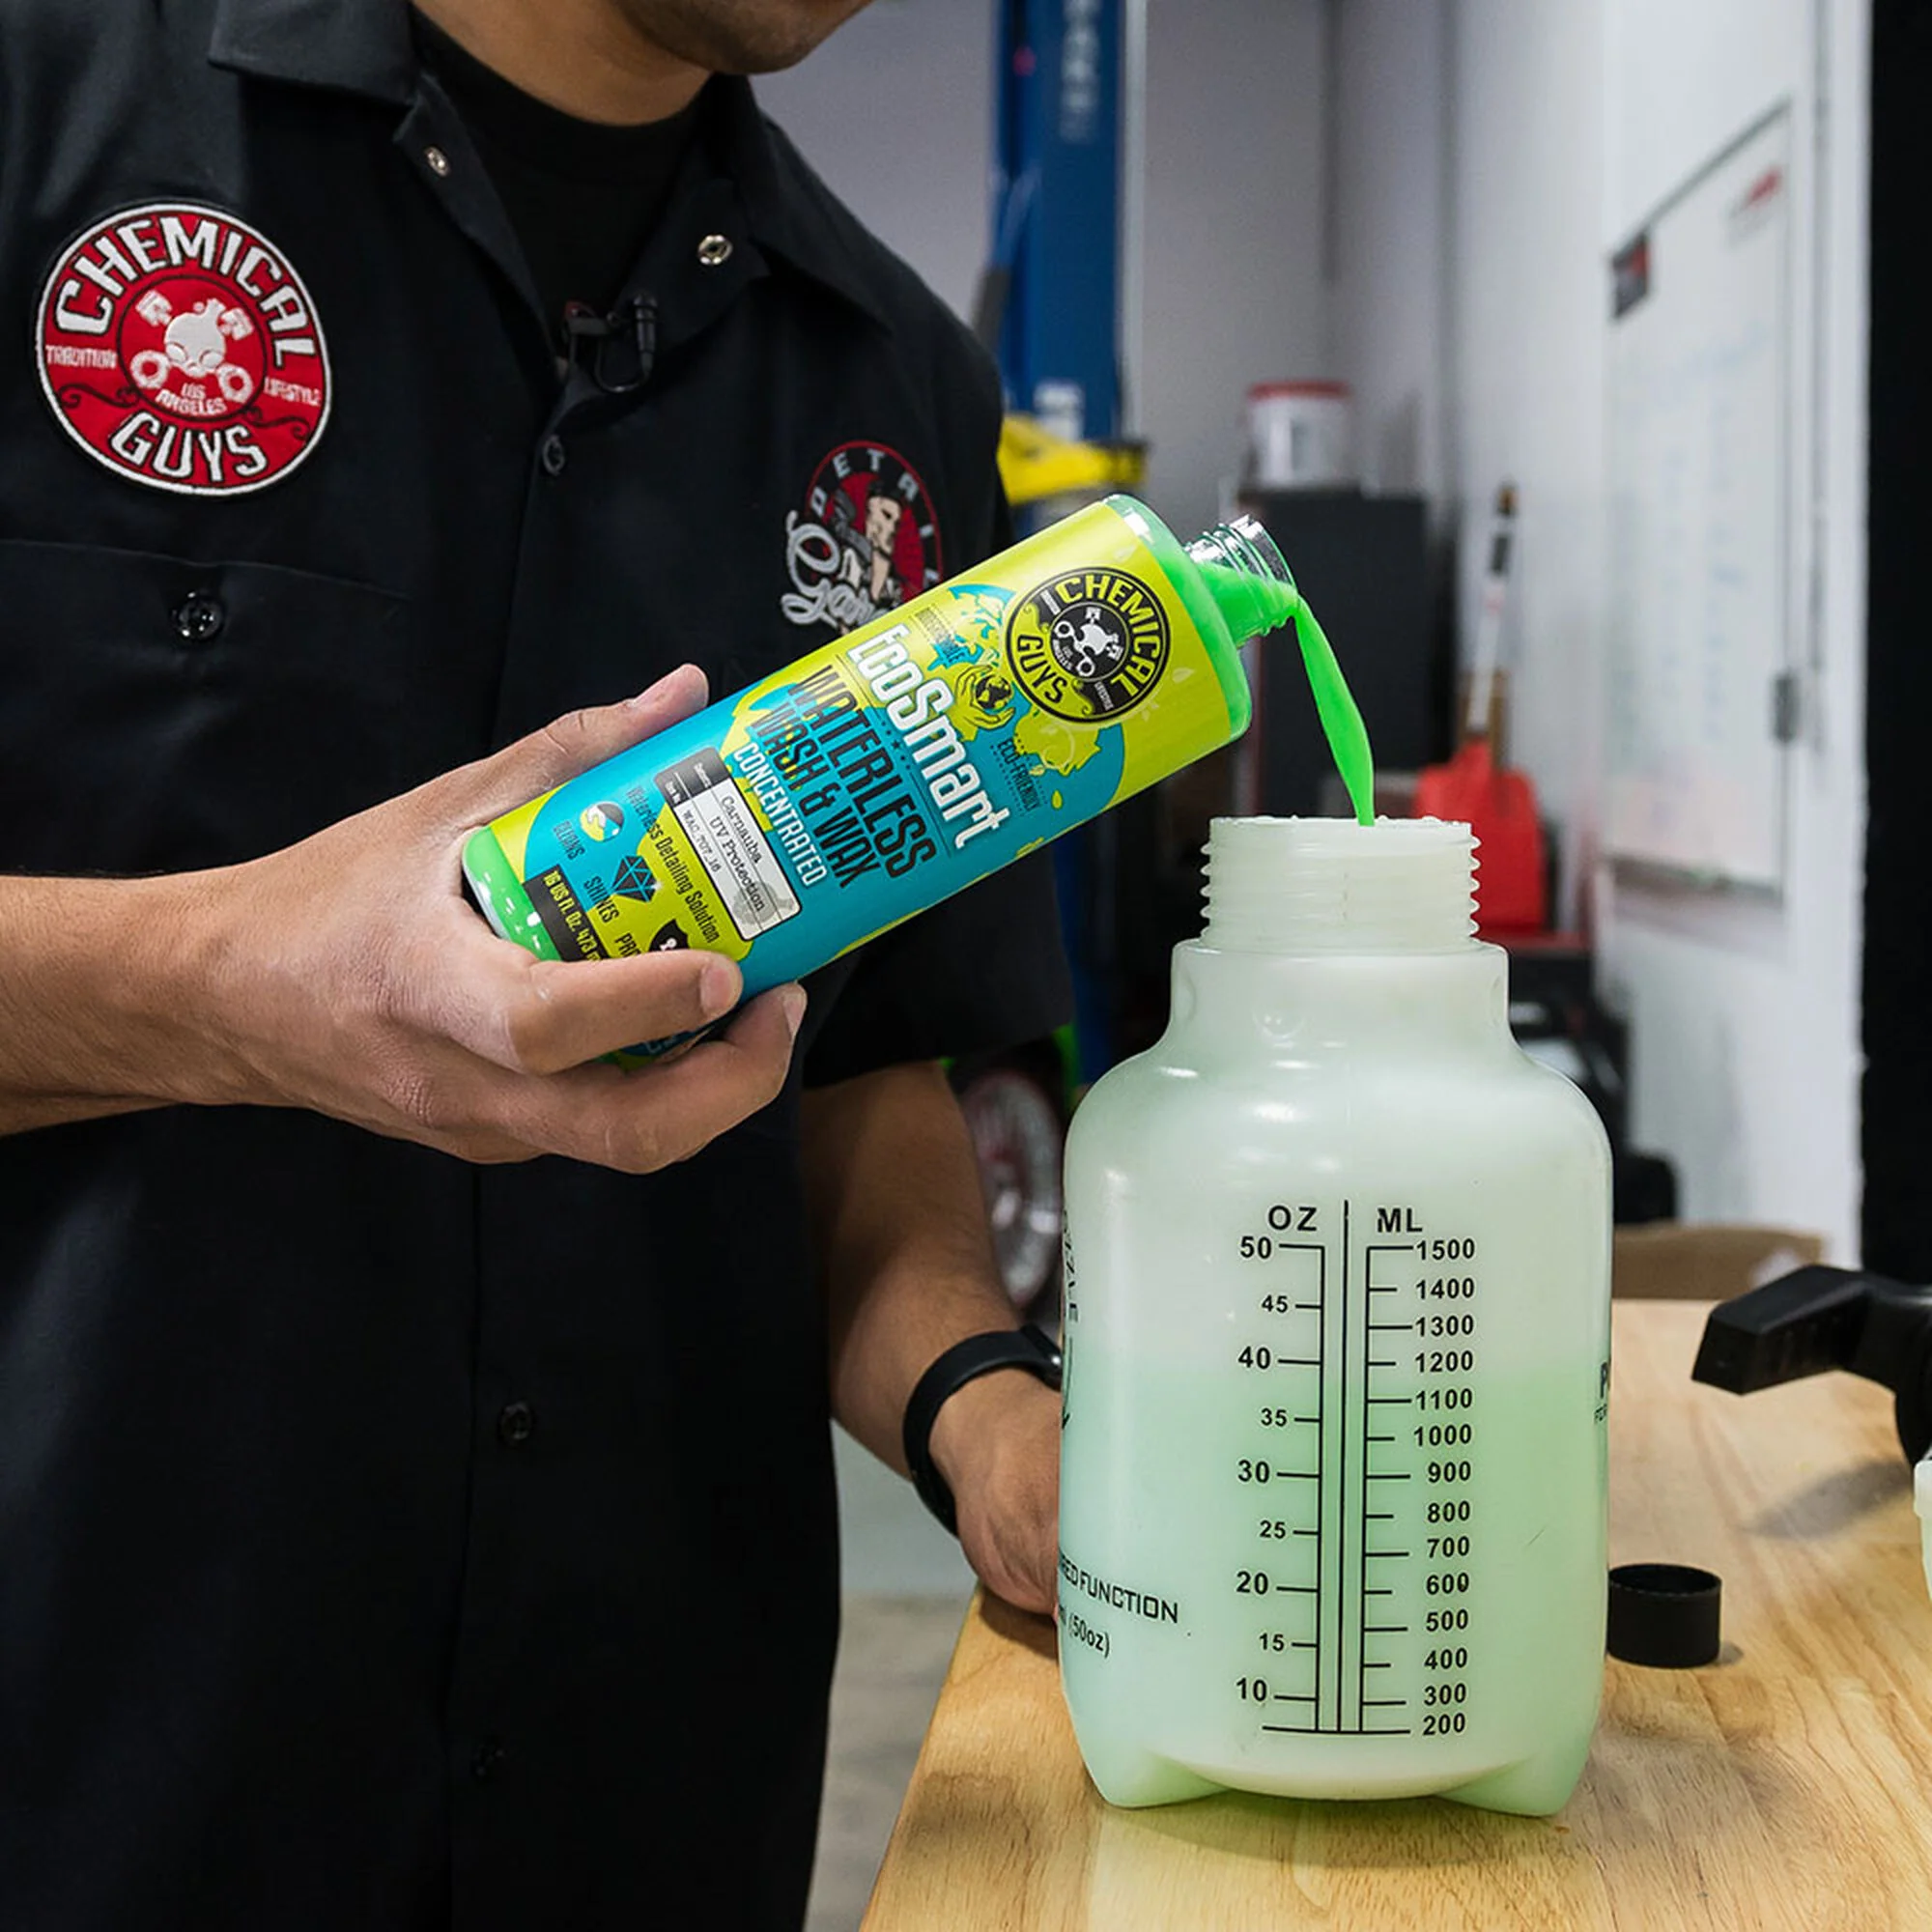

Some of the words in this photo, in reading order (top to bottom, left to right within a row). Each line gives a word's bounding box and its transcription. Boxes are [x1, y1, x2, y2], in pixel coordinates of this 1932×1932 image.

[55, 216, 317, 369] CHEMICAL
[111, 411, 269, 483] GUYS
[1054, 573, 1161, 698] CHEMICAL
[1017, 633, 1071, 704] GUYS
[749, 700, 832, 792] WASH
[846, 623, 1010, 850] EcoSmart
[787, 664, 938, 879] WATERLESS
[800, 781, 840, 817] &
[734, 742, 829, 888] CONCENTRATED
[722, 795, 763, 864] Carnauba
[812, 807, 882, 890] WAX
[709, 815, 730, 838] UV
[722, 838, 765, 913] Protection
[543, 870, 562, 888] 16
[655, 836, 695, 895] Detailing
[684, 890, 721, 944] Solution
[550, 883, 571, 902] US
[582, 875, 620, 923] SHINES
[576, 928, 598, 953] 473
[1268, 1205, 1318, 1232] OZ
[1378, 1208, 1423, 1233] ML
[1241, 1236, 1271, 1259] 50
[1416, 1238, 1475, 1260] 1500
[1416, 1278, 1474, 1299] 1400
[1262, 1295, 1288, 1313] 45
[1415, 1315, 1473, 1336] 1300
[1238, 1347, 1270, 1369] 40
[1415, 1350, 1473, 1372] 1200
[1415, 1388, 1472, 1410] 1100
[1261, 1408, 1287, 1427] 35
[1413, 1424, 1471, 1446] 1000
[1237, 1460, 1269, 1483] 30
[1428, 1462, 1471, 1483] 900
[1428, 1501, 1470, 1522] 800
[1260, 1520, 1286, 1539] 25
[1427, 1536, 1470, 1558] 700
[1236, 1571, 1268, 1594] 20
[1426, 1573, 1469, 1595] 600
[1080, 1569, 1178, 1624] FUNCTION
[1426, 1609, 1469, 1632] 500
[1068, 1612, 1110, 1659] (50oz)
[1259, 1634, 1285, 1651] 15
[1424, 1648, 1467, 1669] 400
[1236, 1678, 1267, 1701] 10
[1424, 1684, 1466, 1706] 300
[1423, 1713, 1465, 1735] 200
